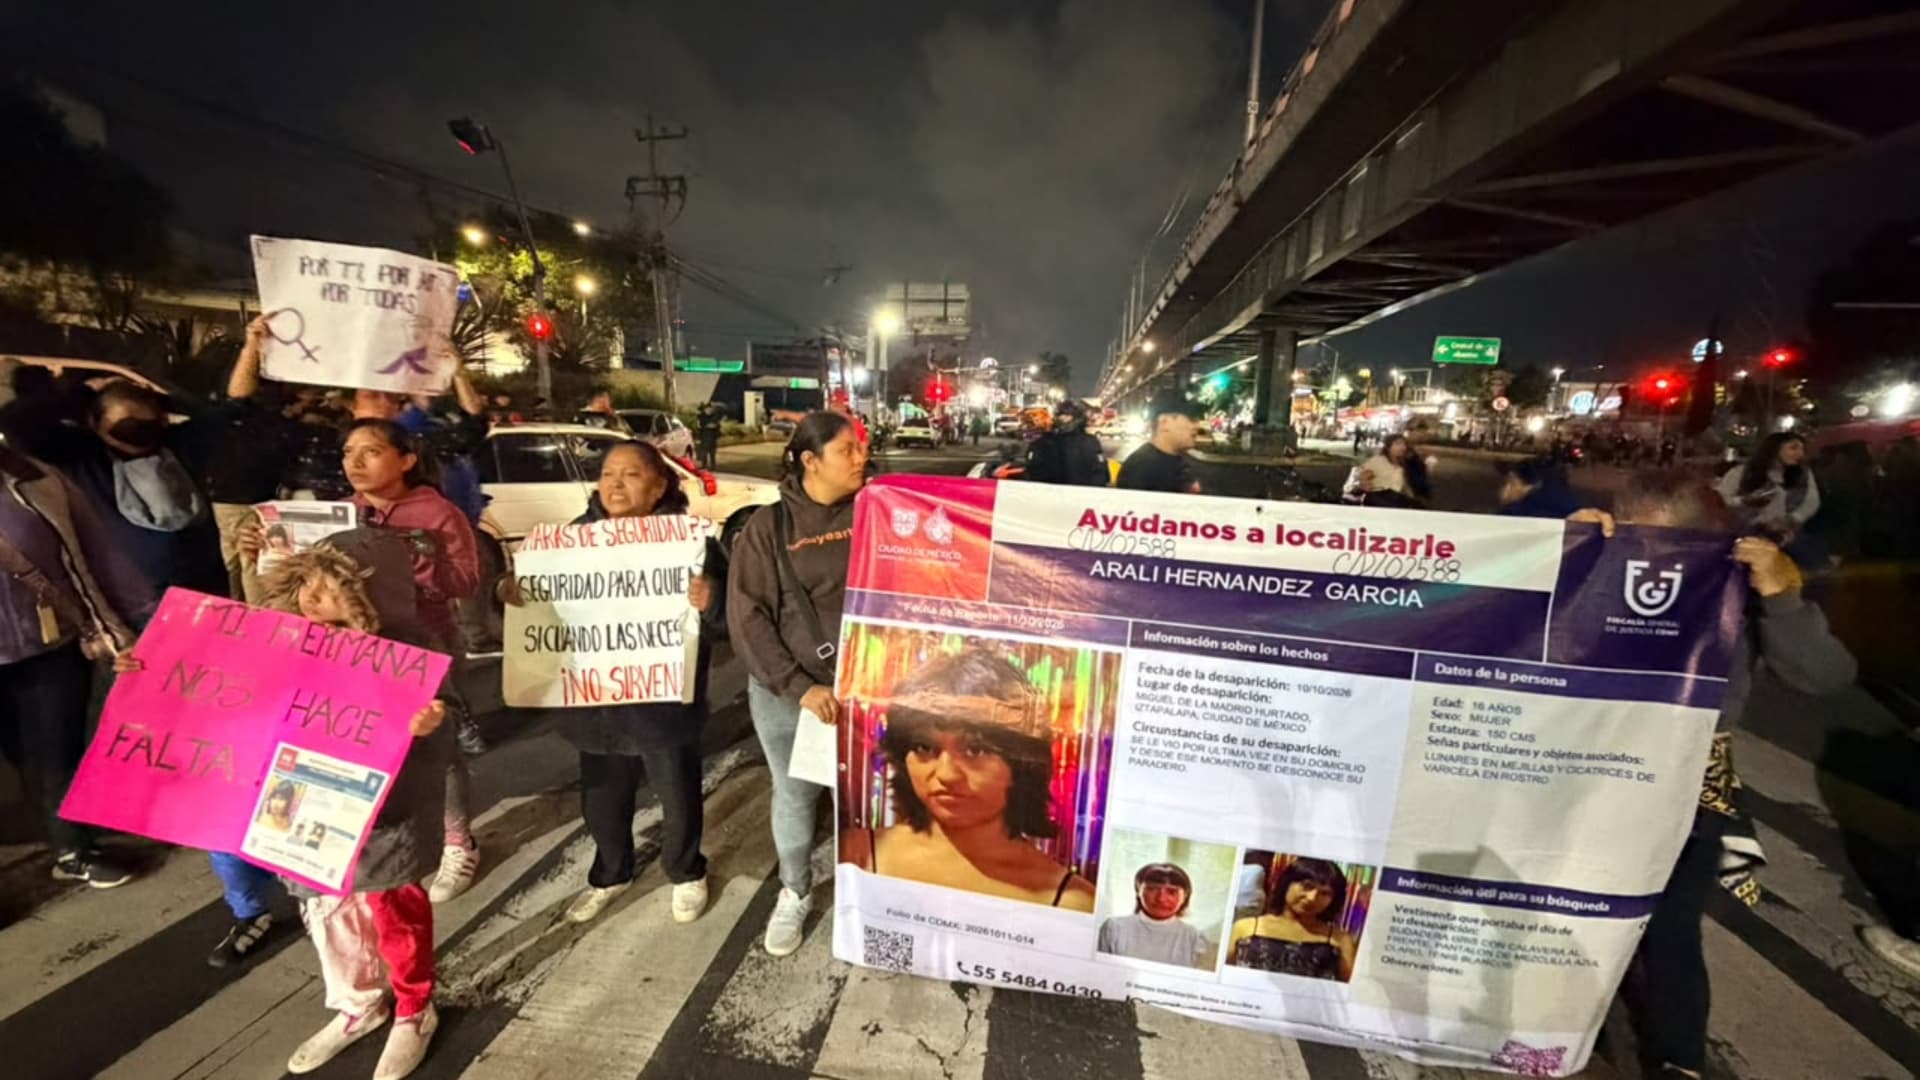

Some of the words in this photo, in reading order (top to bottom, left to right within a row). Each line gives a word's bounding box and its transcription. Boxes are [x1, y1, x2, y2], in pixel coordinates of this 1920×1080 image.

[359, 286, 417, 313] TODAS
[578, 520, 600, 547] DE
[1077, 508, 1237, 541] Ayúdanos
[1247, 527, 1264, 543] a
[1276, 524, 1455, 558] localizarle
[519, 571, 605, 603] SEGURIDAD
[608, 570, 650, 598] PARA
[652, 566, 690, 595] QUIE
[1090, 560, 1158, 583] ARALI
[1165, 567, 1313, 598] HERNANDEZ
[1325, 582, 1424, 608] GARCIA
[606, 622, 637, 651] LAS
[1144, 630, 1218, 649] Información
[1222, 638, 1256, 654] sobre
[1259, 642, 1278, 657] los
[1281, 646, 1328, 662] hechos
[268, 616, 428, 686] HERMANA
[1138, 662, 1174, 677] Fecha
[1176, 668, 1192, 679] de
[1194, 669, 1205, 681] la
[1208, 672, 1291, 691] desaparición:
[1435, 662, 1472, 677] Datos
[1475, 667, 1492, 679] de
[1495, 668, 1507, 681] la
[1510, 673, 1568, 688] persona
[1136, 692, 1175, 706] MIGUEL
[1177, 697, 1192, 707] DE
[1194, 698, 1208, 709] LA
[1210, 700, 1252, 714] MADRID
[1137, 677, 1173, 693] Lugar
[1174, 681, 1189, 693] de
[1191, 685, 1272, 704] desaparición:
[1432, 696, 1465, 709] Edad:
[283, 688, 383, 745] HACE
[1202, 712, 1243, 726] CIUDAD
[1245, 716, 1260, 727] DE
[1431, 709, 1461, 721] Sexo:
[1469, 714, 1512, 726] MUJER
[1133, 721, 1220, 743] Circunstancias
[1223, 733, 1238, 745] de
[1241, 737, 1257, 747] su
[1258, 738, 1341, 758] desaparición:
[1426, 735, 1460, 749] Señas
[1463, 741, 1531, 759] particulares
[1429, 723, 1479, 738] Estatura:
[1510, 732, 1536, 743] CMS
[106, 723, 234, 783] FALTA
[1131, 735, 1144, 745] SE
[1146, 737, 1160, 747] LE
[1162, 738, 1180, 750] VIO
[1183, 741, 1205, 753] POR
[1250, 749, 1269, 761] VEZ
[1272, 752, 1287, 763] EN
[1290, 754, 1306, 765] SU
[1308, 756, 1366, 774] DOMICILIO
[1138, 747, 1173, 760] DESDE
[1177, 751, 1198, 763] ESE
[1200, 754, 1254, 770] MOMENTO
[1257, 762, 1272, 773] SE
[1274, 764, 1344, 782] DESCONOCE
[1346, 773, 1363, 785] SU
[1425, 751, 1479, 767] LUNARES
[1482, 758, 1498, 768] EN
[1397, 876, 1474, 897] Información
[1499, 891, 1527, 903] para
[1530, 895, 1544, 904] su
[1547, 894, 1610, 912] búsqueda
[1394, 903, 1456, 921] Vestimenta
[973, 964, 996, 980] 55
[1001, 968, 1048, 990] 5484
